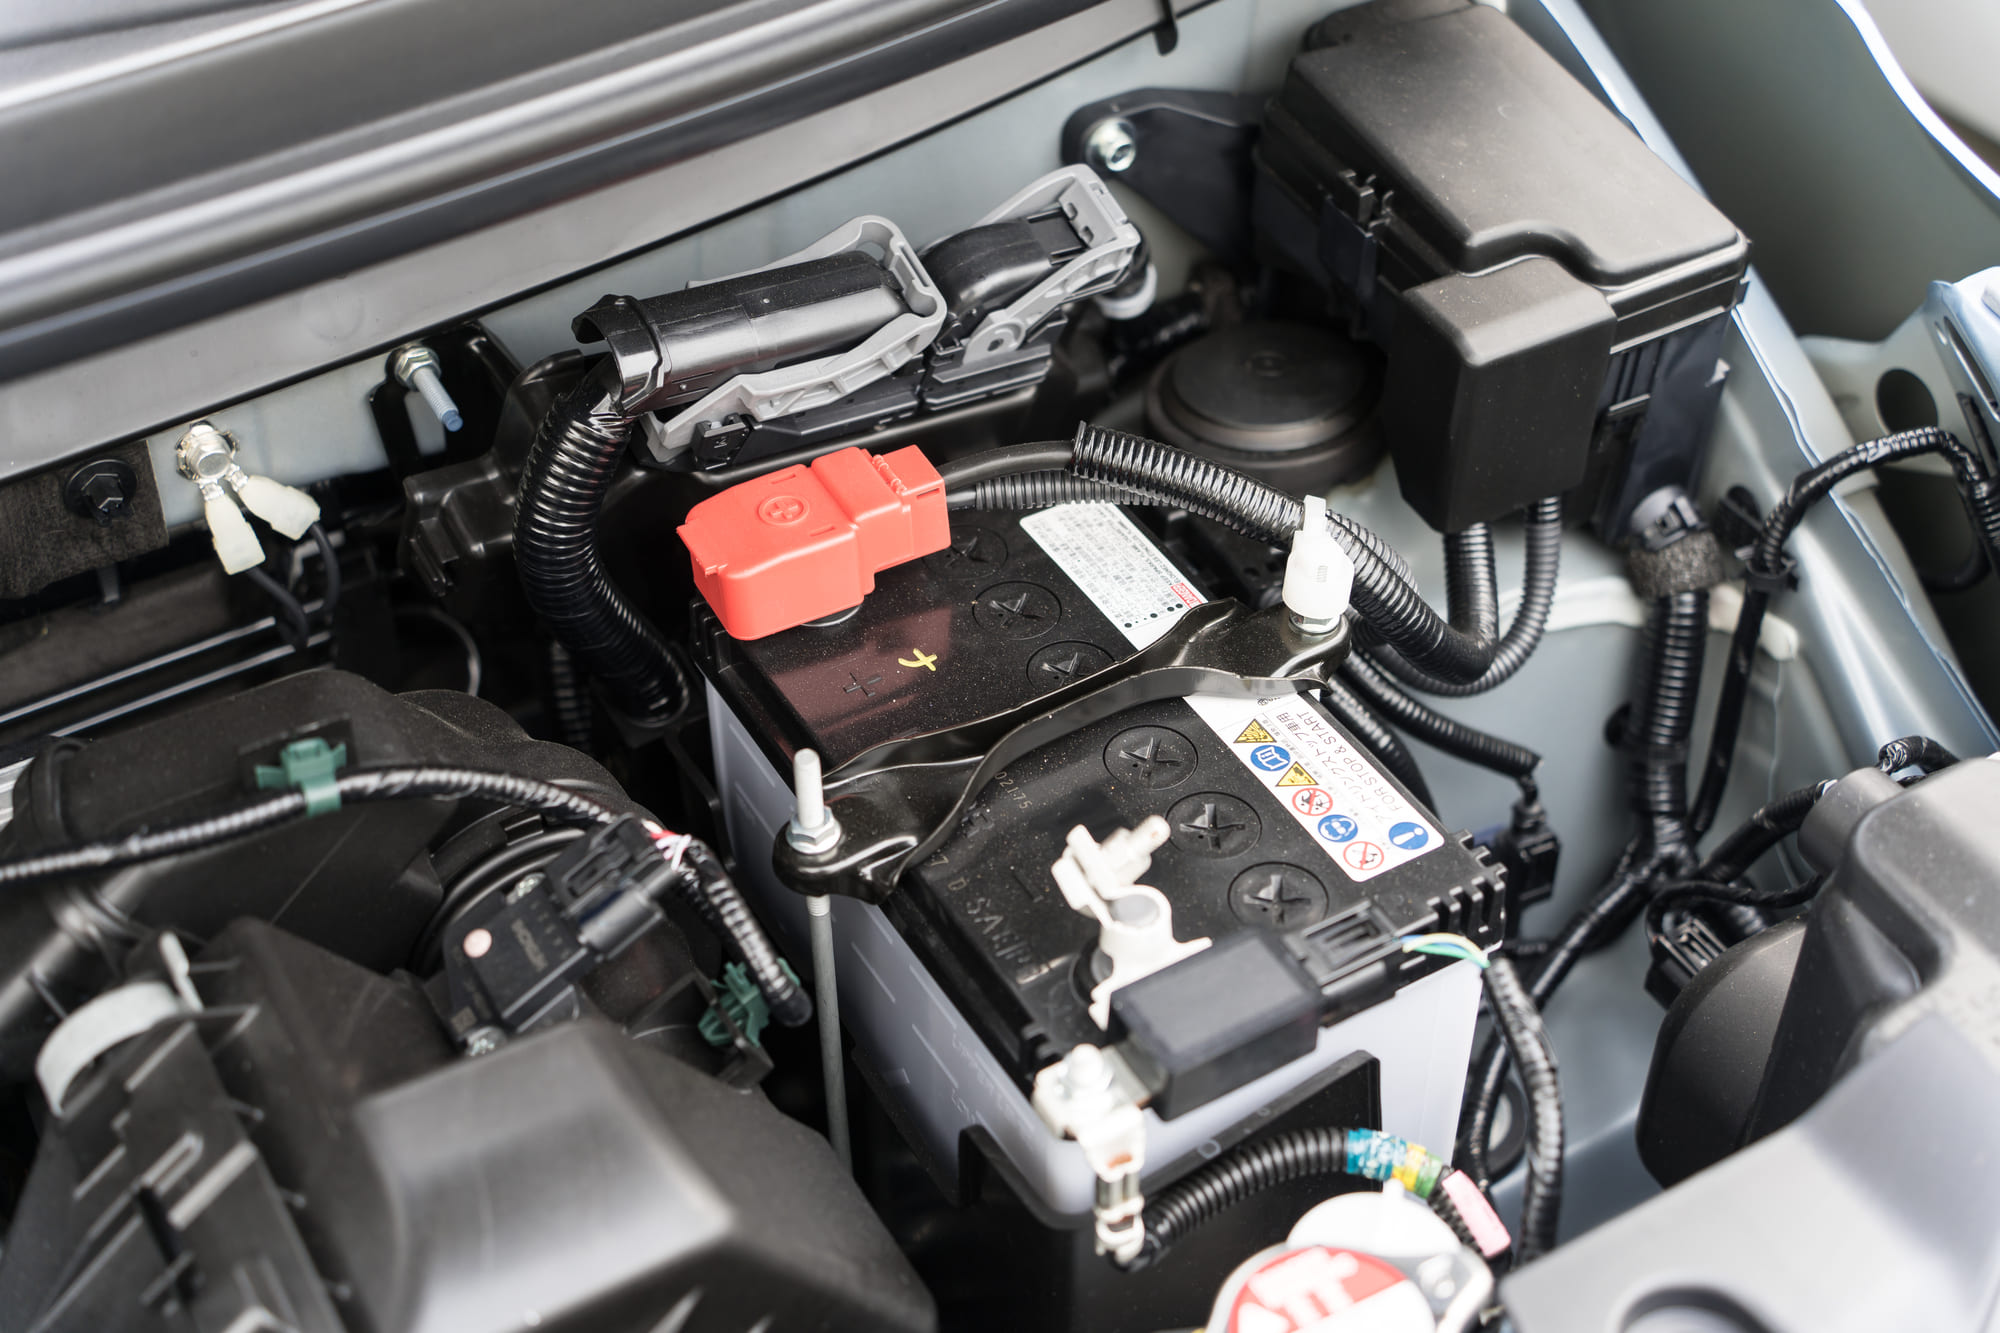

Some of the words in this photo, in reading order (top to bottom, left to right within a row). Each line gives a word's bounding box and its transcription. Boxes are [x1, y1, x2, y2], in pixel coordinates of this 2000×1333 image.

[1296, 712, 1337, 745] START
[1334, 745, 1347, 754] &
[1343, 758, 1377, 786] STOP
[1374, 787, 1403, 811] FOR
